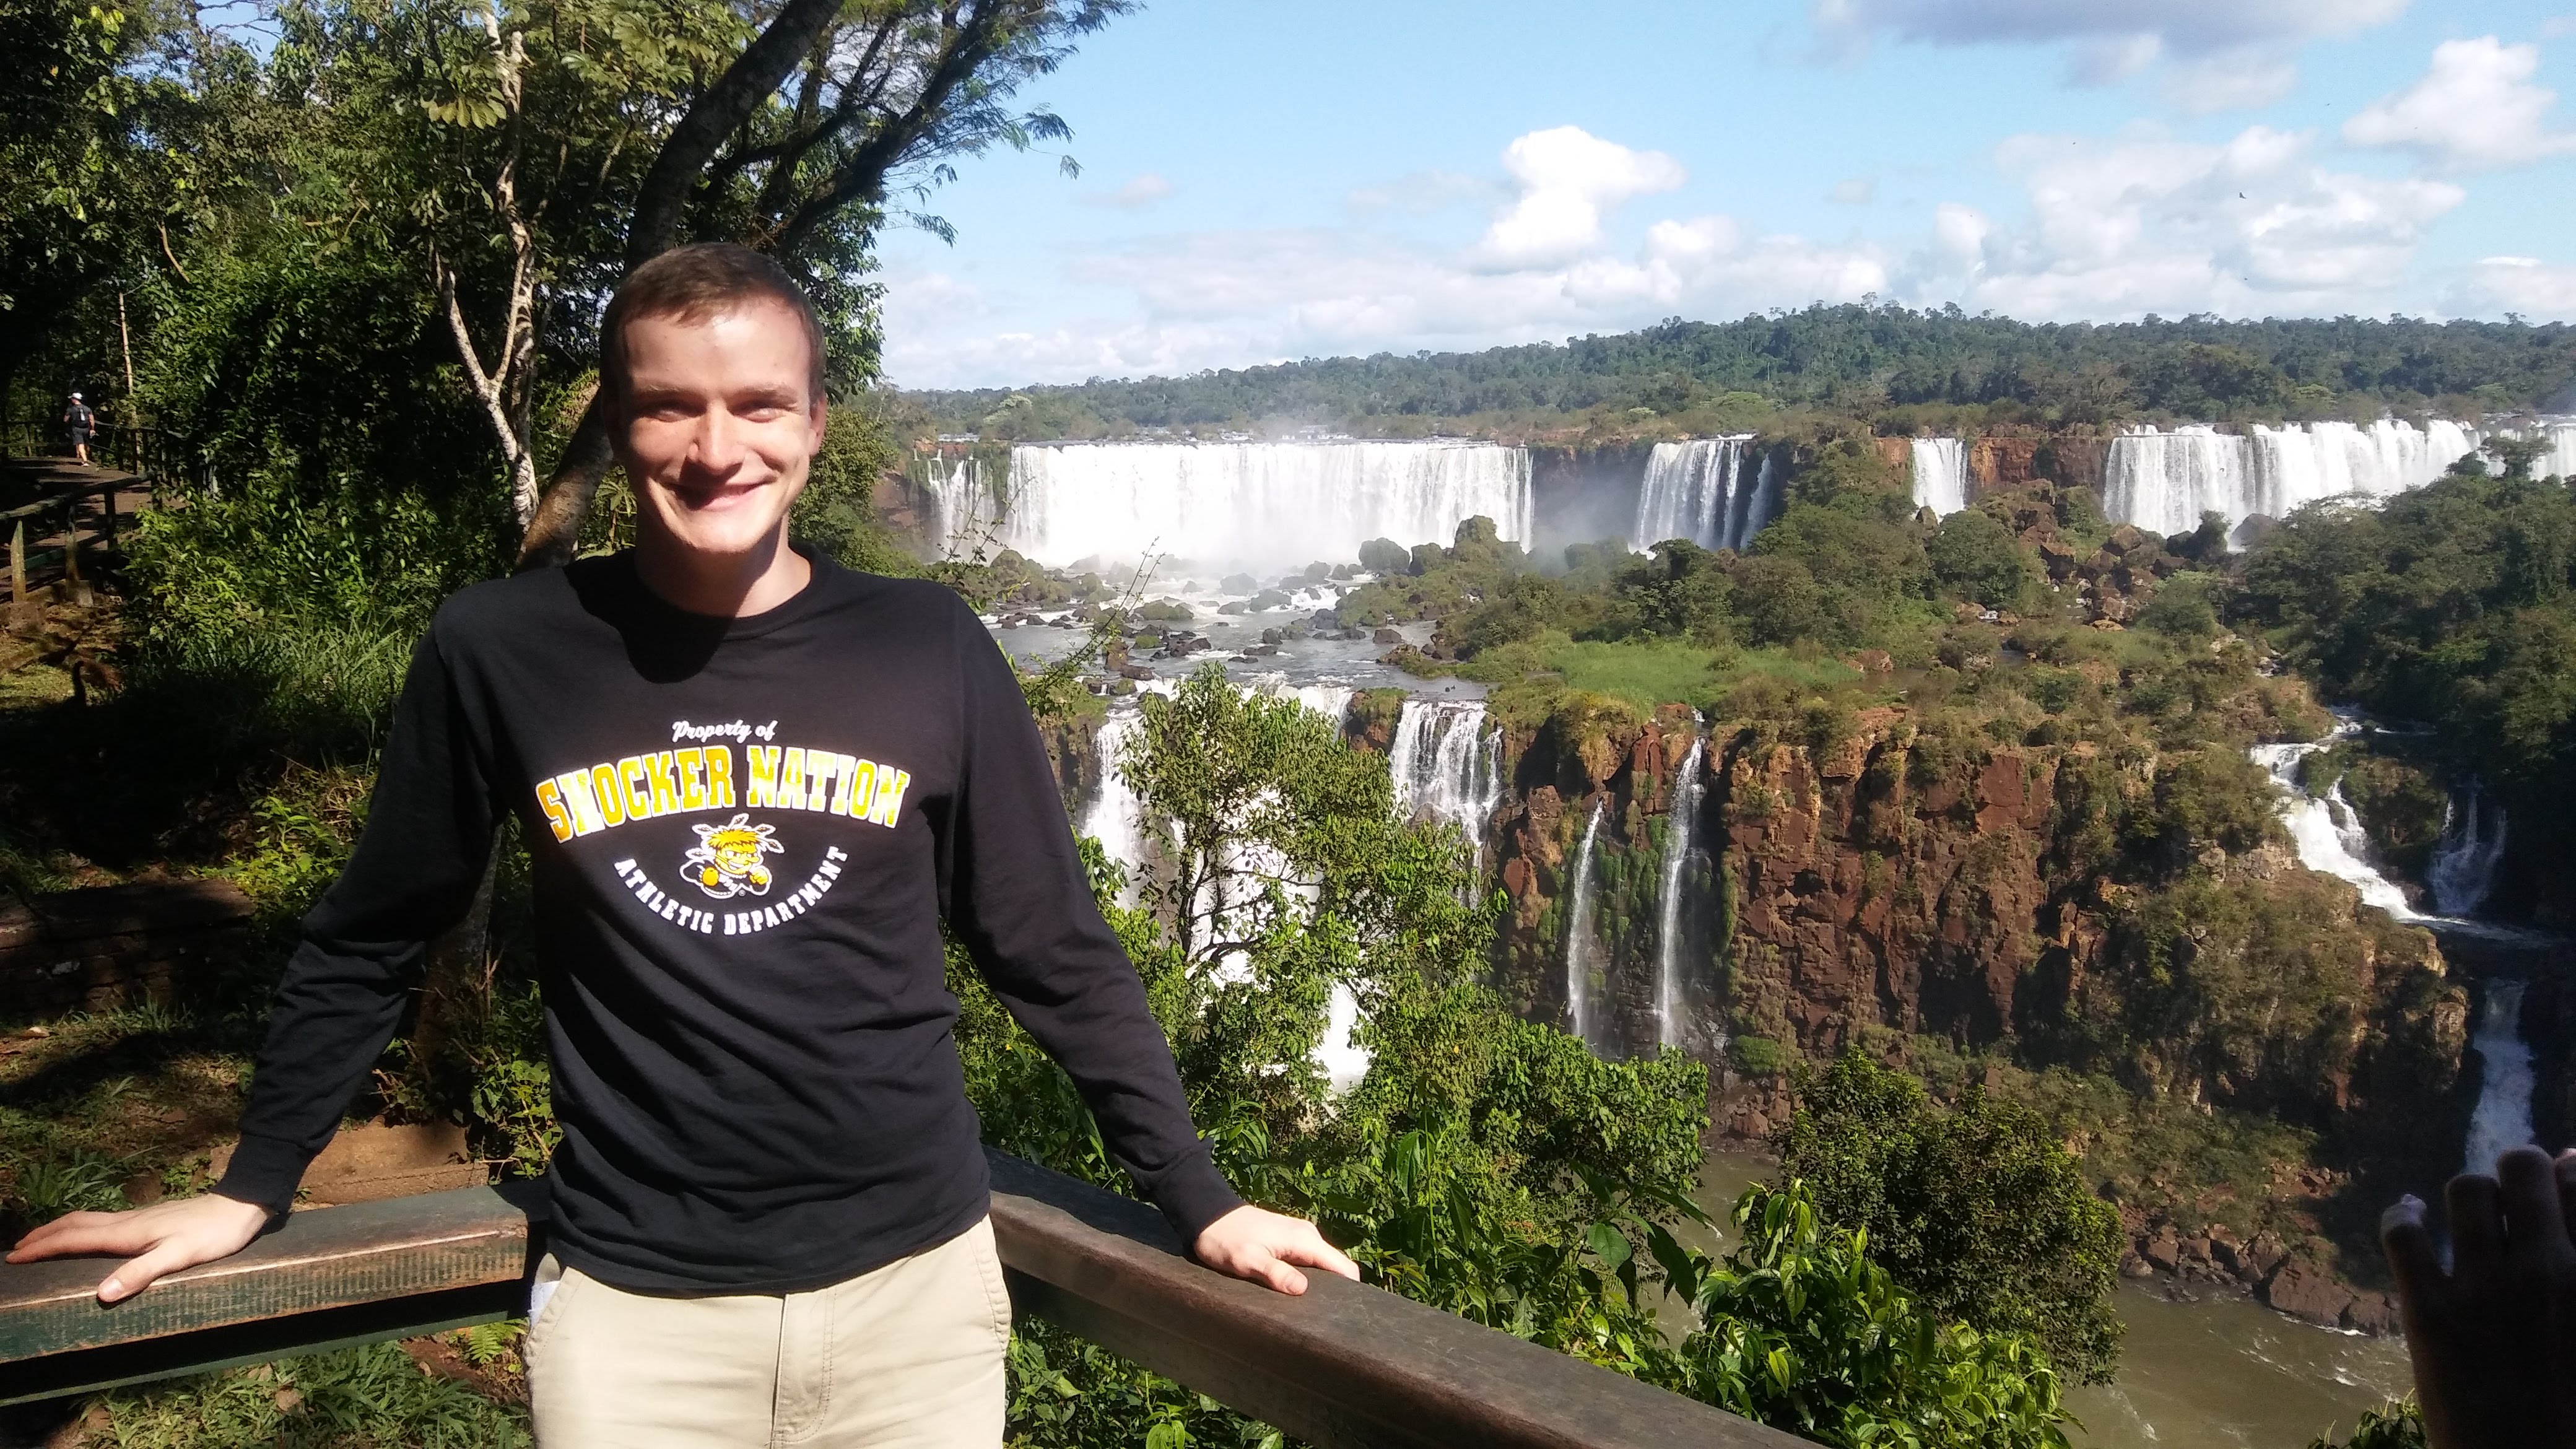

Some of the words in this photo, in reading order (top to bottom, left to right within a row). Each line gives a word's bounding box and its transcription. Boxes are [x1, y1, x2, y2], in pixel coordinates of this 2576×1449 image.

[672, 720, 751, 742] Property
[755, 720, 778, 741] of
[536, 745, 736, 844] SHOCKER
[747, 746, 911, 827] NATION
[615, 858, 714, 935] ATHLETIC
[724, 846, 848, 935] DEPARTMENT
